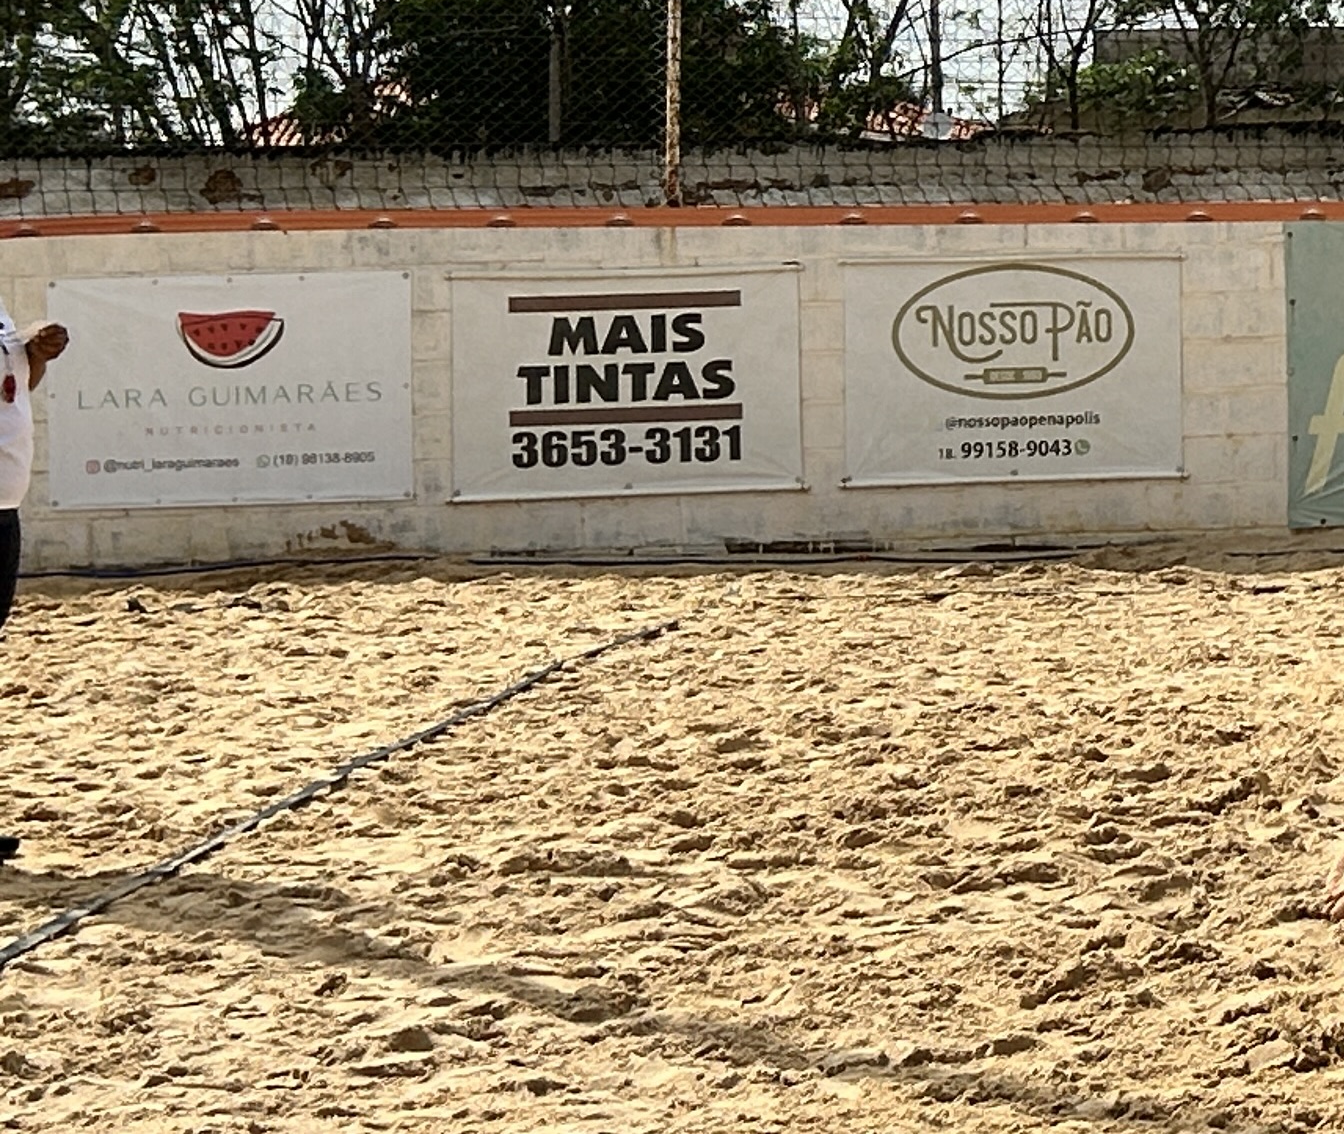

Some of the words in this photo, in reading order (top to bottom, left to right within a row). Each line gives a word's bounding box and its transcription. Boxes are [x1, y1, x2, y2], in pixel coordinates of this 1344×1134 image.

[548, 313, 705, 356] MAIS
[915, 304, 1038, 363] NOSSO
[990, 300, 1112, 361] PÃO
[77, 388, 168, 410] LARA
[188, 381, 383, 407] GUIMARÃES
[516, 360, 735, 405] TINTAS
[144, 422, 317, 437] NUTRICIONISTA
[945, 411, 1101, 430] @nossopaopenapolis
[511, 425, 742, 469] 3653-3131
[961, 439, 1073, 459] 99158-9043
